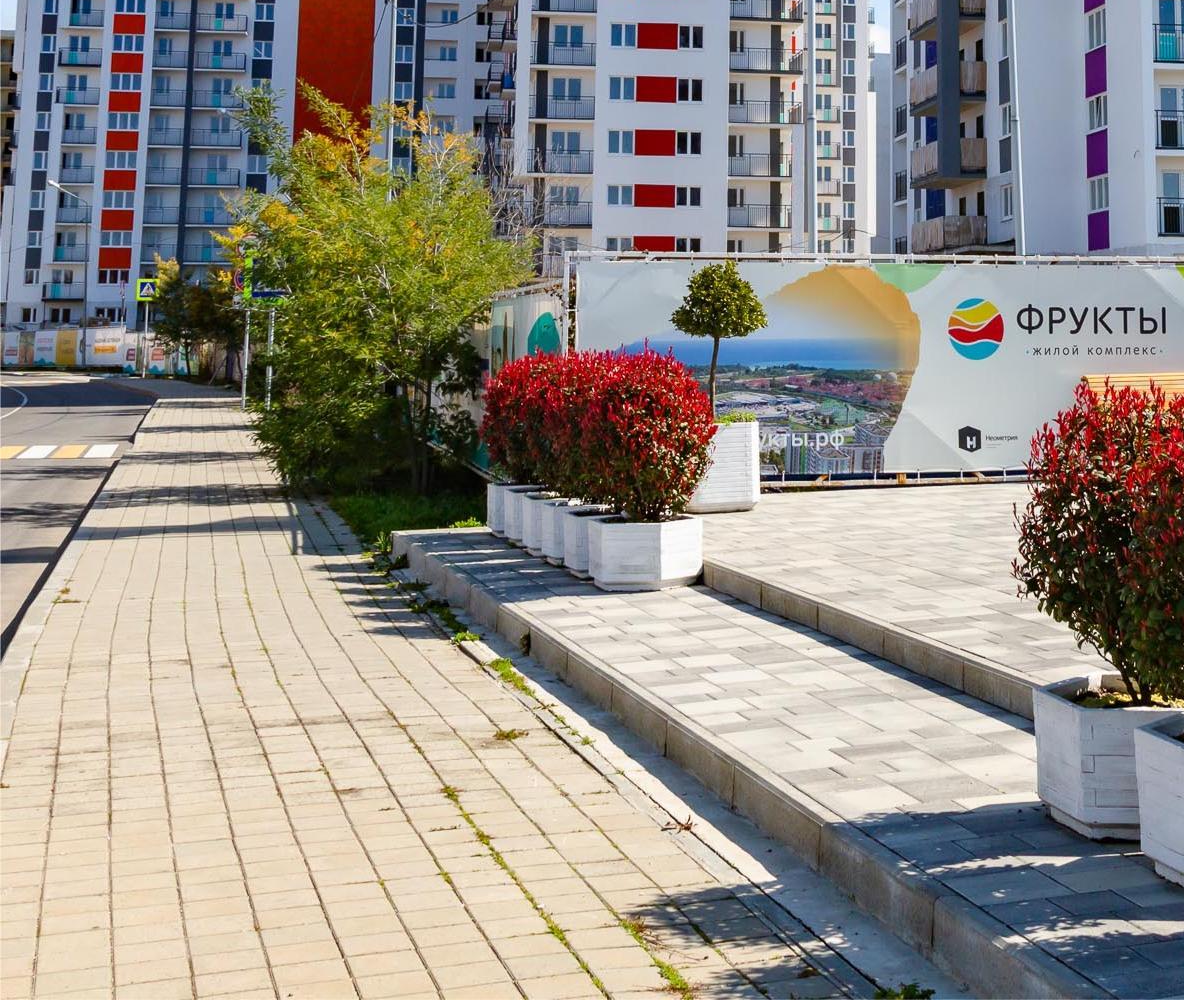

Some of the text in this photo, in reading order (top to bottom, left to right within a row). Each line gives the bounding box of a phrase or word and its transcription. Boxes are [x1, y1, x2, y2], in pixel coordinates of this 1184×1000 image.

[1016, 303, 1167, 335] ФРУКТЫ
[1033, 345, 1158, 356] жилой комплекс
[759, 429, 844, 450] укты.рф
